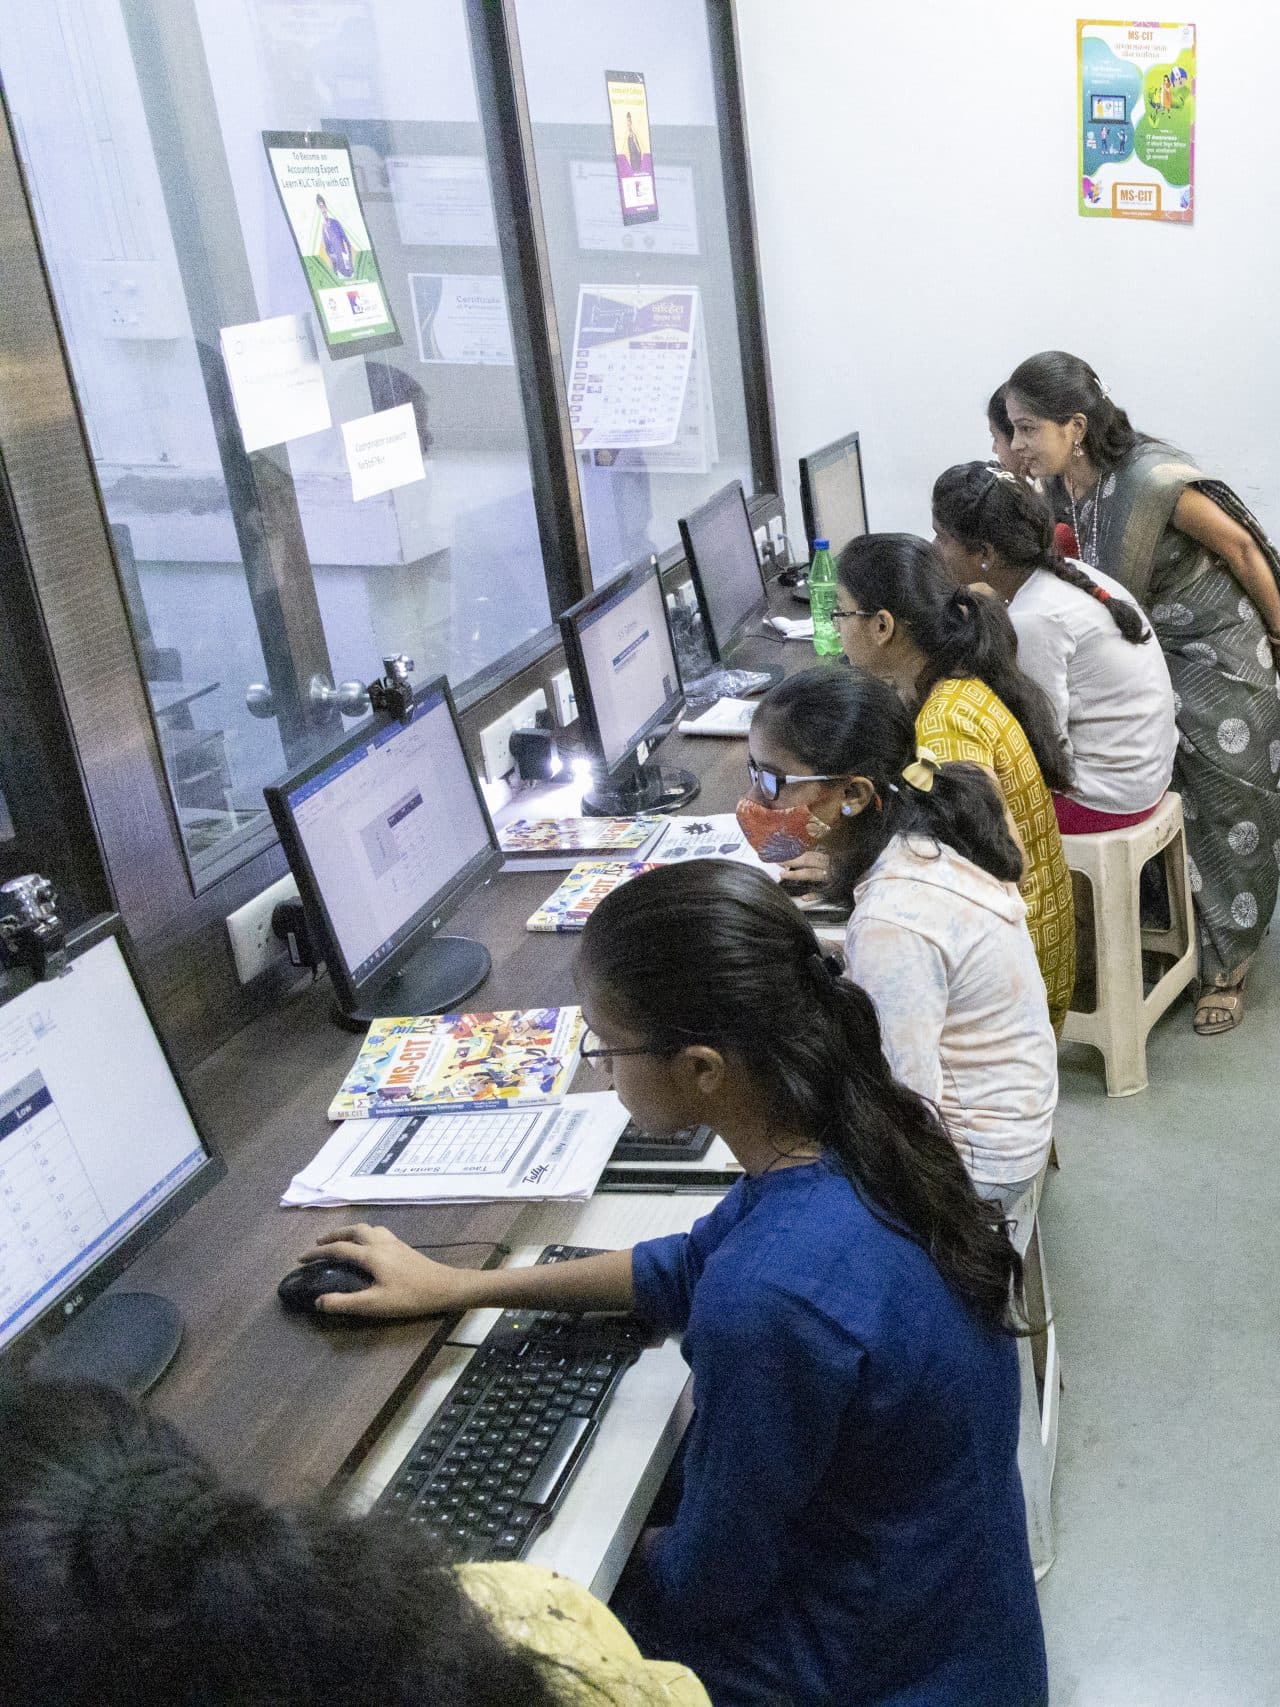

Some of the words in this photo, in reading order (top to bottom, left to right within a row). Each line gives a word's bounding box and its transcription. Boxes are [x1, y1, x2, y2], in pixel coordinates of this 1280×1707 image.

[291, 151, 300, 161] To
[300, 152, 320, 161] Become
[287, 164, 320, 177] Accounting
[320, 164, 339, 176] Expert
[281, 178, 299, 189] Learn
[311, 177, 326, 190] Tally
[1120, 189, 1153, 202] MS-CIT
[385, 1039, 433, 1085] MS-CIT
[15, 1103, 33, 1120] Low
[521, 1163, 551, 1185] Tally
